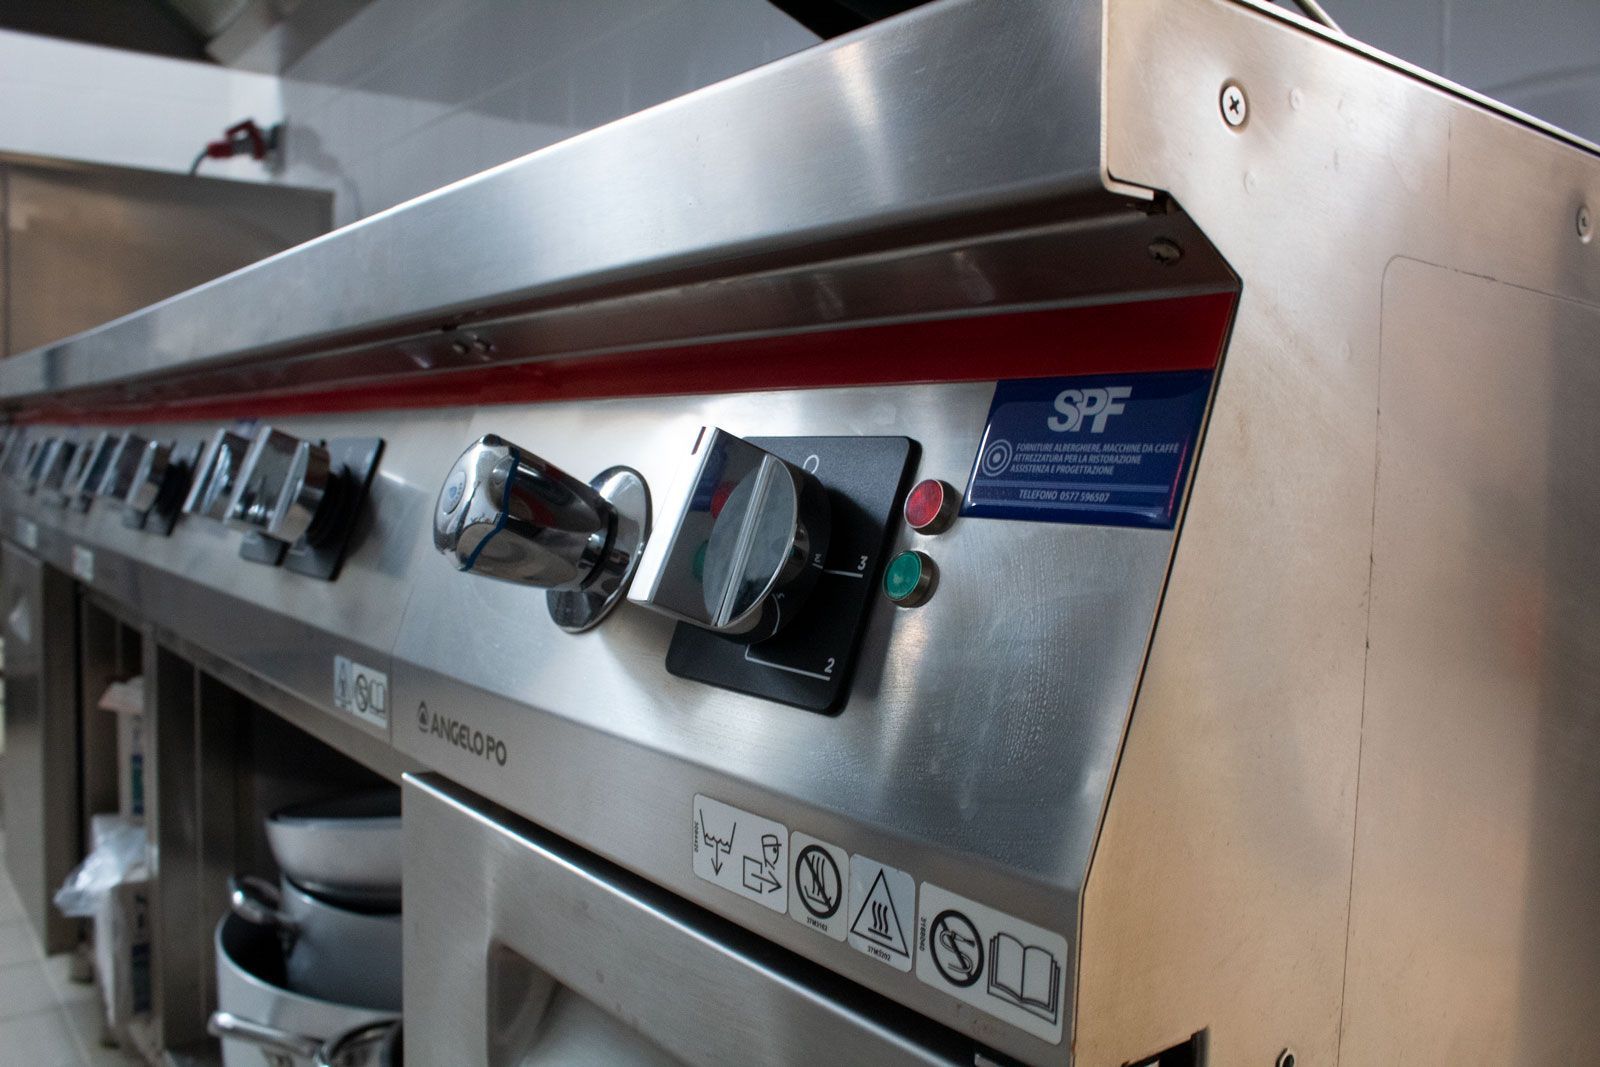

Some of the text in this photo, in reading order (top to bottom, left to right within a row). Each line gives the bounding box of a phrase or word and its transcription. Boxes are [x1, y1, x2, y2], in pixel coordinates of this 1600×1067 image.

[1047, 386, 1133, 434] SPF
[1016, 442, 1053, 453] FORNITURE
[1102, 443, 1141, 453] MACCHINE
[1142, 443, 1154, 453] DA
[1013, 453, 1141, 465] ATTREZZATURA PER LA RISTORAZIONE
[1010, 464, 1050, 474] ASSISTENZA
[1055, 465, 1115, 476] PROGETTAZIONE
[1019, 489, 1109, 502] TELEFONO 0577 596507
[857, 554, 869, 571] 3
[824, 657, 836, 674] 2
[430, 712, 507, 767] ANGELO PO
